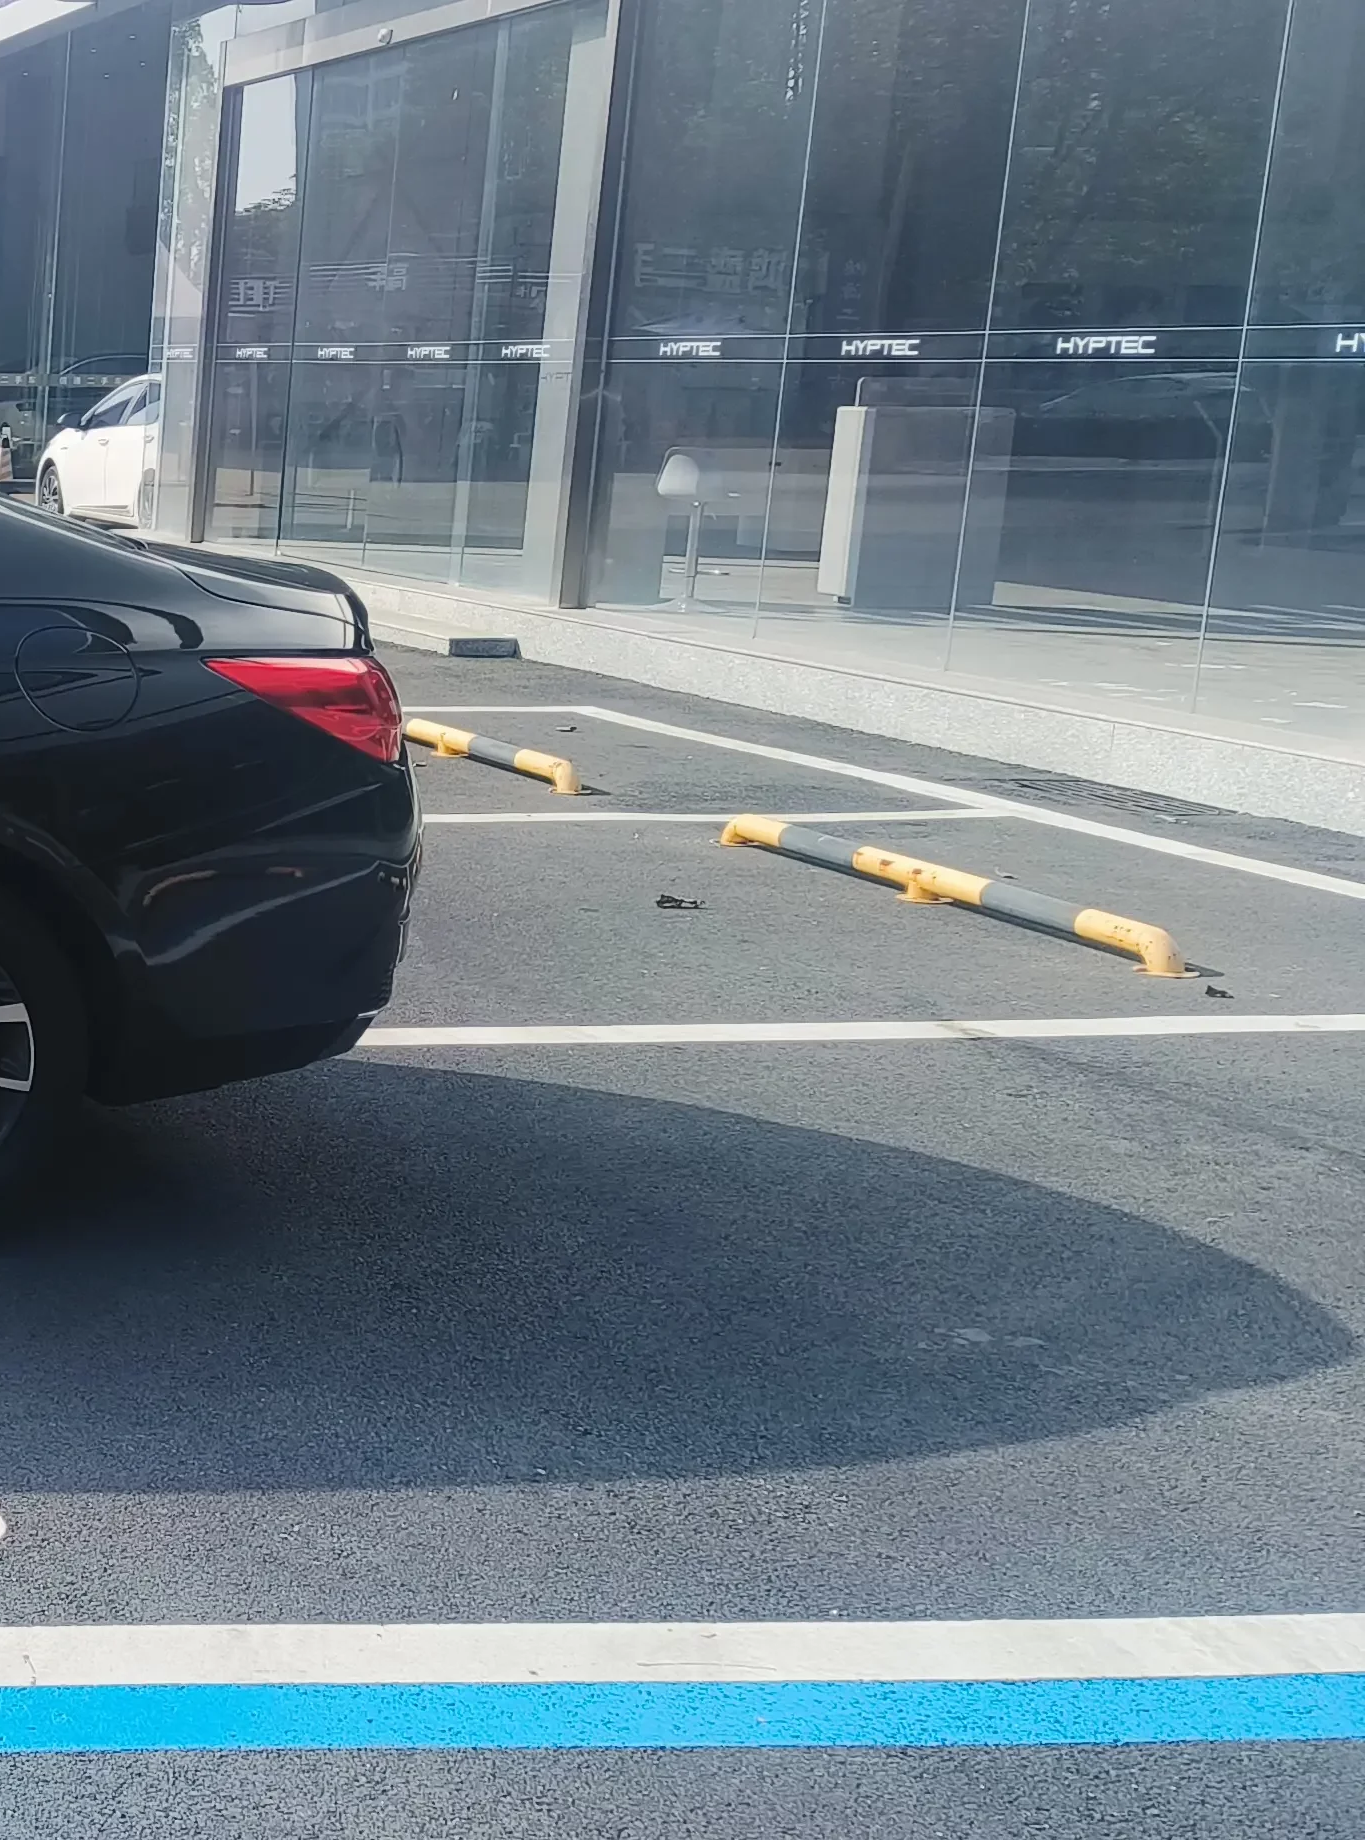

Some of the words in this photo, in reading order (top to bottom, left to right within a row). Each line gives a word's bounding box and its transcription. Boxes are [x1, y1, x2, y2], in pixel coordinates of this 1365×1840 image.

[501, 344, 551, 358] HYPTEC
[659, 341, 722, 356] HYPTEC
[840, 339, 920, 356] HYPTEC
[1055, 335, 1157, 354] HYPTEC
[235, 347, 269, 358] HYPTEC
[317, 347, 355, 359] HYPTEC
[407, 346, 451, 359] HYPTEC
